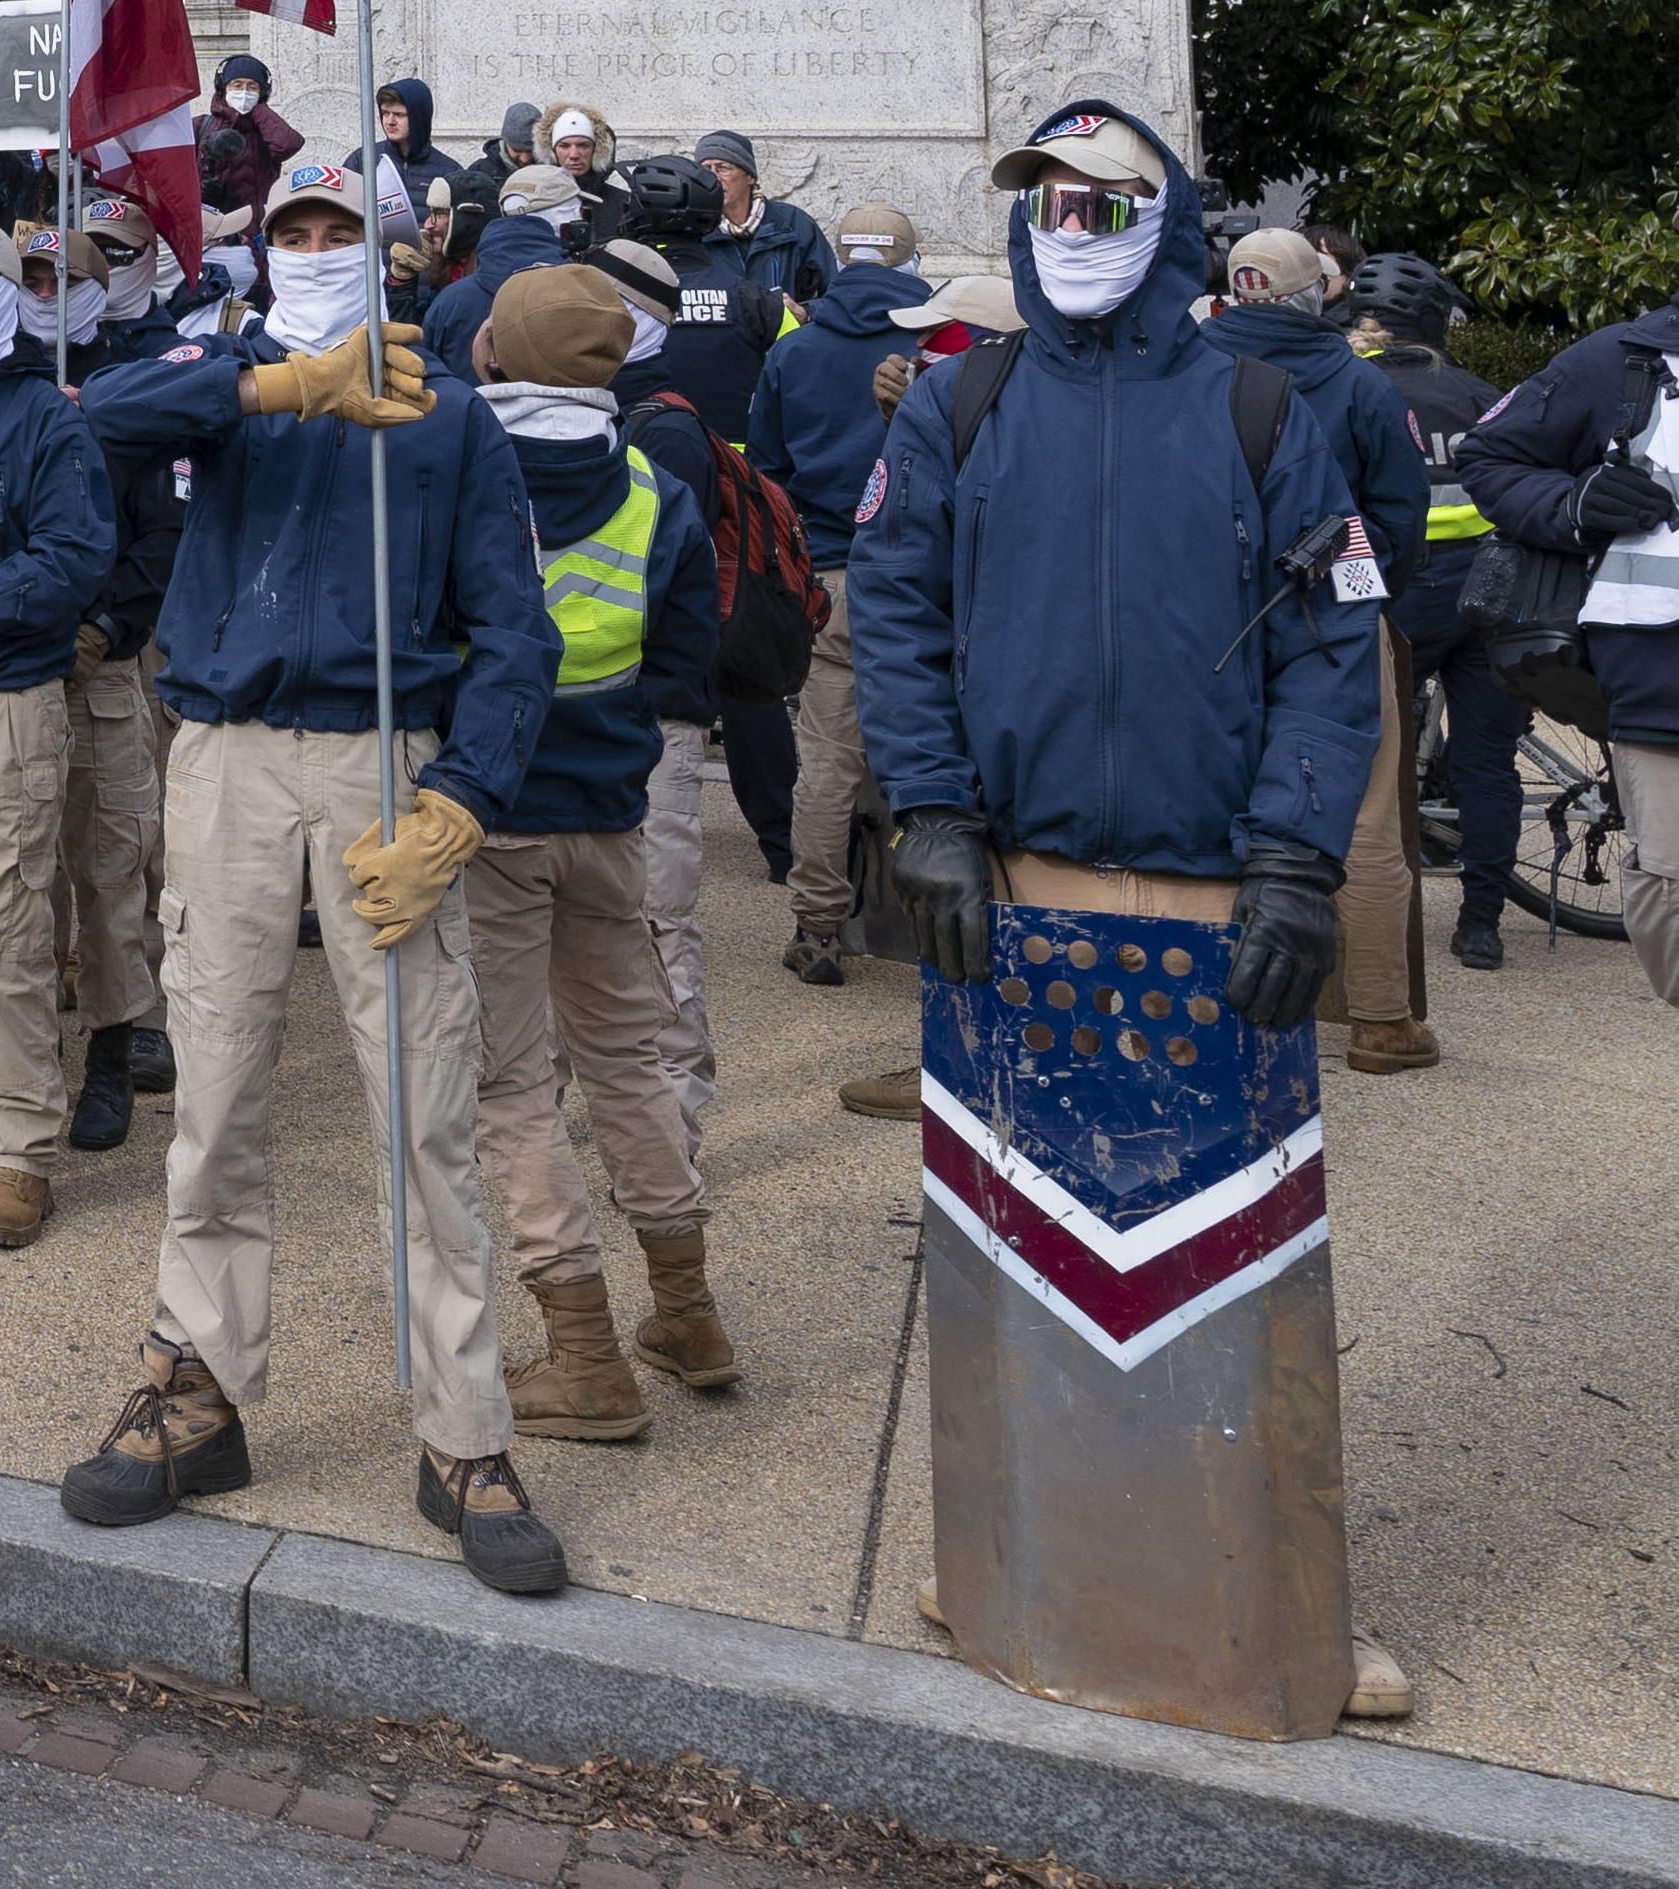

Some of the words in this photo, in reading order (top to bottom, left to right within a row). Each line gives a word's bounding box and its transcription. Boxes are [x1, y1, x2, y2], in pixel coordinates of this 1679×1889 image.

[513, 10, 670, 38] ETERNAL
[679, 8, 878, 36] VIGILANCE
[29, 23, 62, 56] NA
[472, 54, 501, 79] IS
[512, 54, 584, 79] THE
[595, 53, 695, 79] PRICE
[710, 53, 757, 78] OF
[773, 50, 922, 78] LIBERTY
[13, 69, 57, 103] FU
[680, 289, 728, 305] OLITAN
